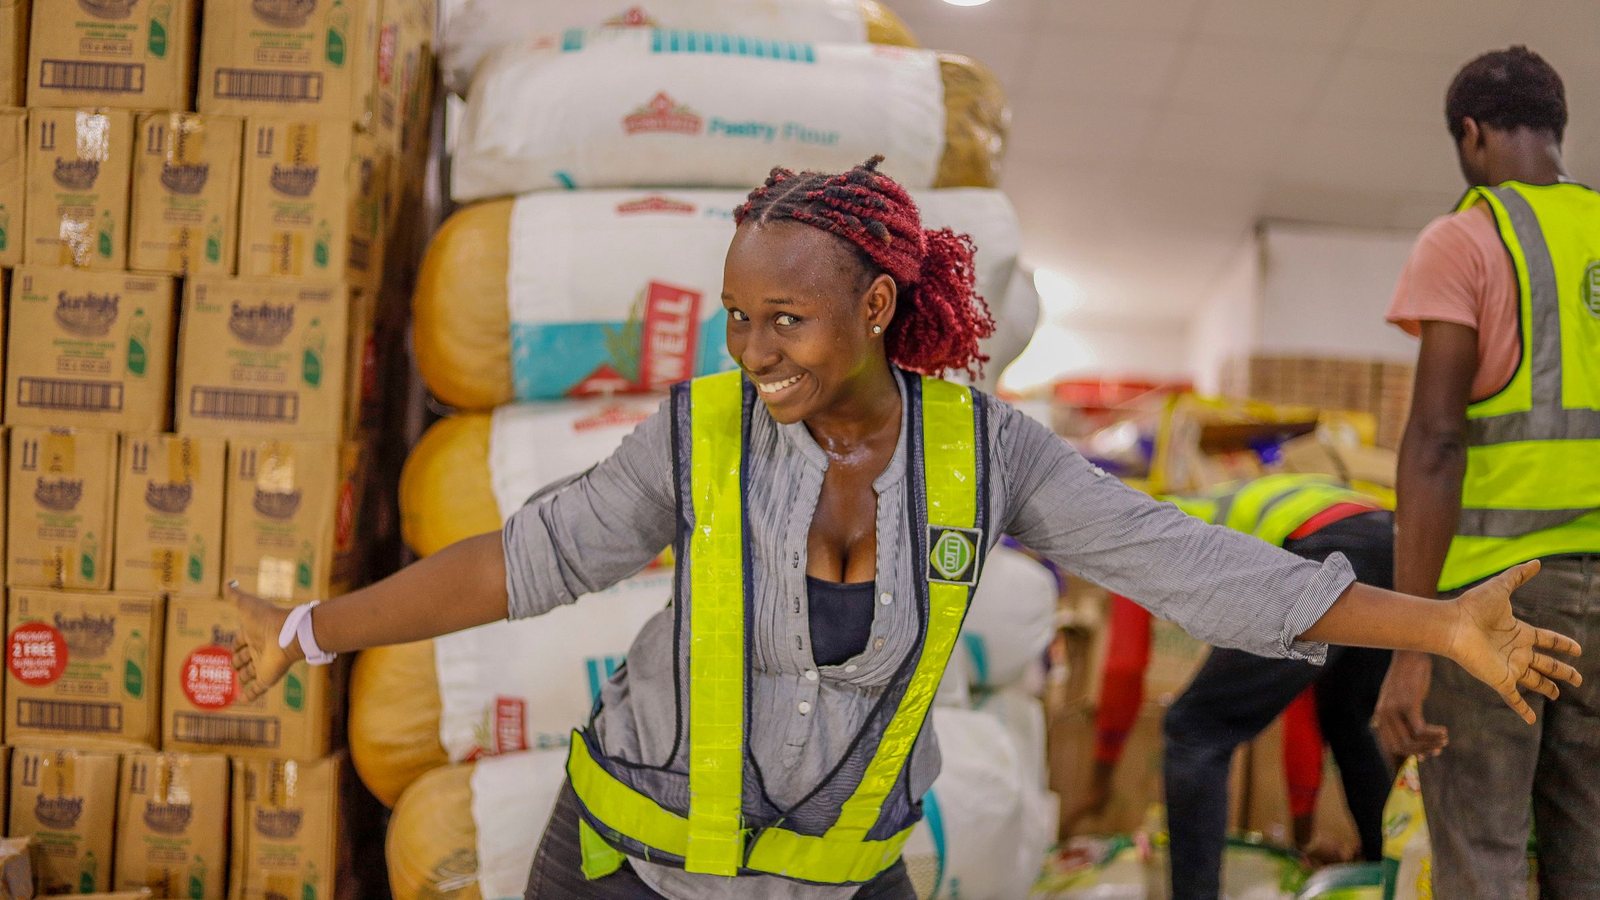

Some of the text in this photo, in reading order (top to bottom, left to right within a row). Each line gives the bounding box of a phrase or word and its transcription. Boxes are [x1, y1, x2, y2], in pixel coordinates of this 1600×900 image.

[709, 117, 777, 141] Pastry
[785, 122, 839, 144] Flour
[57, 289, 121, 314] Sunlight
[650, 294, 693, 386] WELL
[12, 641, 56, 657] 2 FREE
[188, 665, 233, 682] 2 FREE
